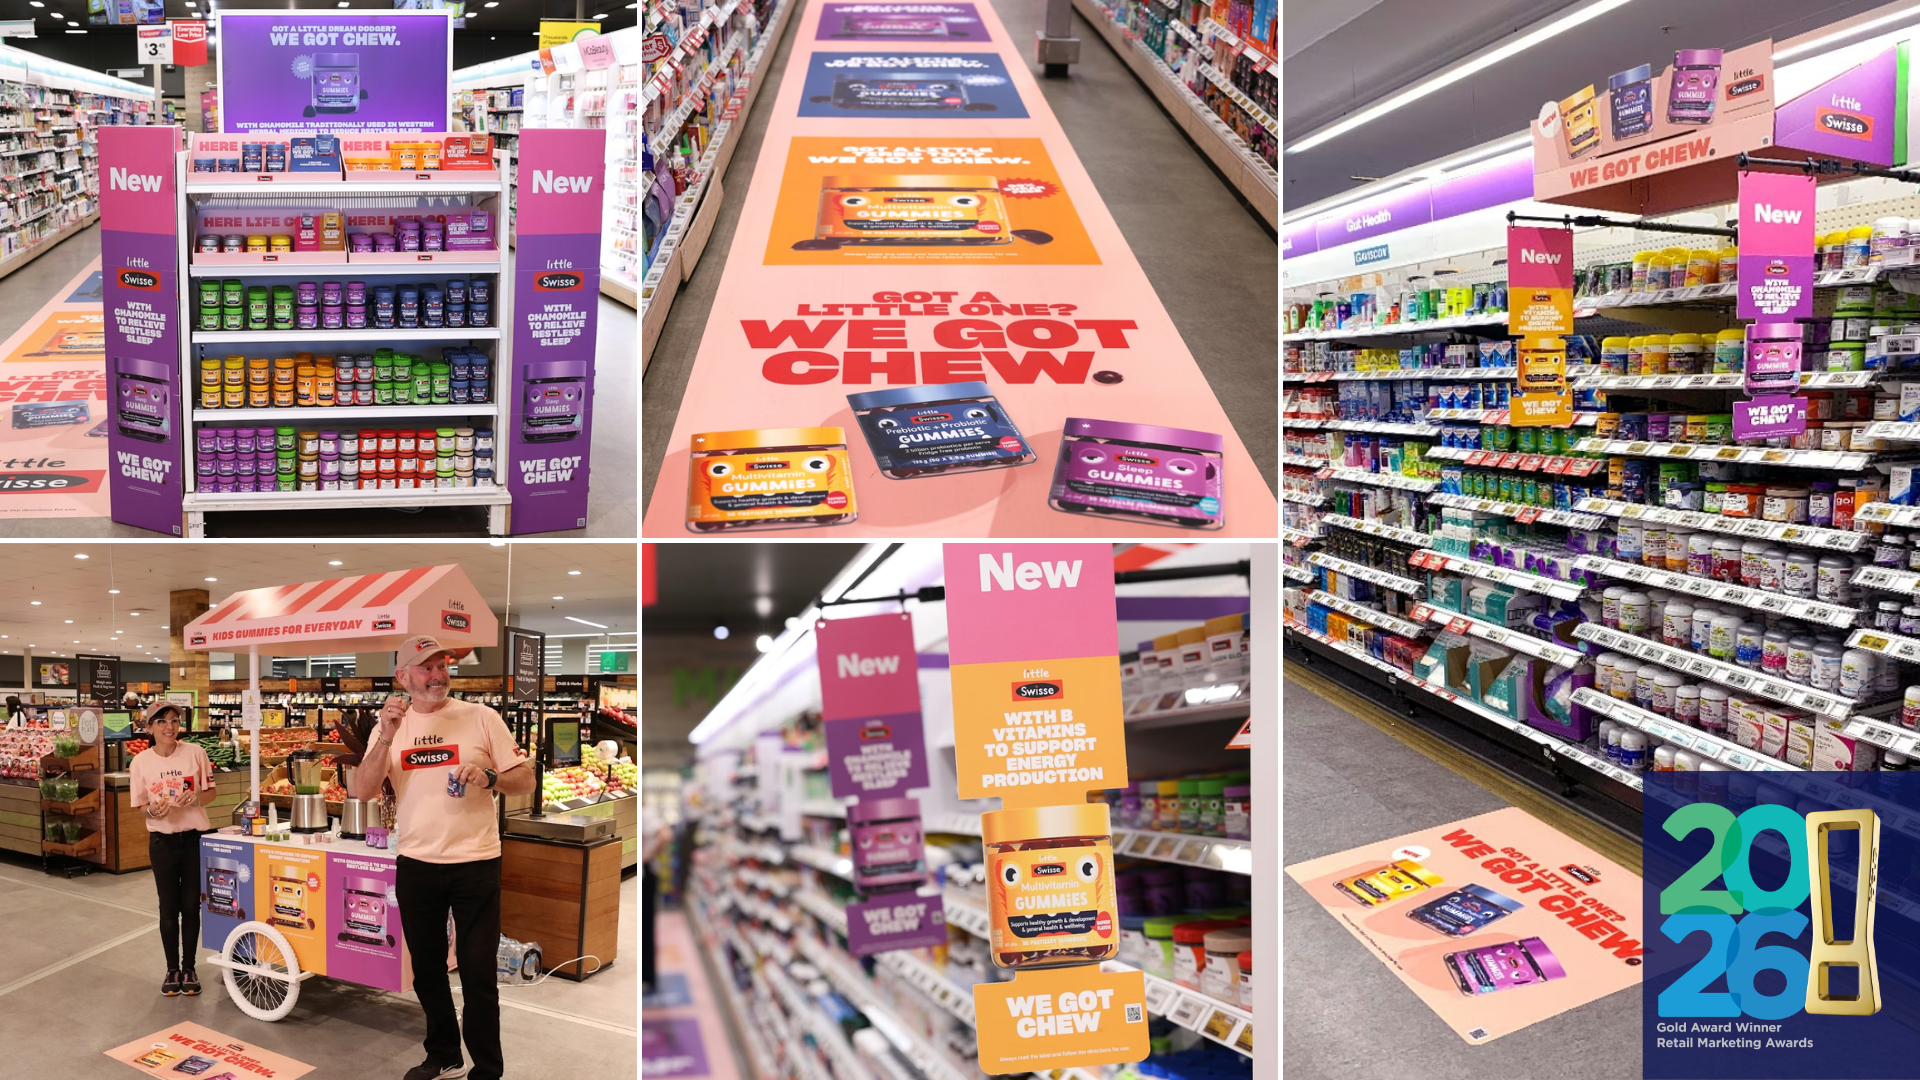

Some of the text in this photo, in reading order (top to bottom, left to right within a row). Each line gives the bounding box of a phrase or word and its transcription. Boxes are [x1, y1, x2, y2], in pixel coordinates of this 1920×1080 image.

[270, 33, 401, 46] WE GOT CHEW.
[148, 43, 159, 56] 3
[1733, 68, 1754, 80] little
[1731, 82, 1758, 95] Swisse
[1831, 94, 1862, 111] little
[1542, 110, 1557, 128] NEW
[1826, 115, 1863, 133] Swisse
[199, 141, 238, 151] HERE
[343, 141, 382, 151] HERE
[1570, 137, 1716, 188] WE GOT CHEW.
[110, 167, 162, 192] New
[532, 170, 593, 194] New
[1346, 208, 1392, 232] Gut Health
[1754, 203, 1802, 224] New
[204, 217, 280, 227] HERE LIFE
[348, 216, 385, 226] HERE
[1355, 247, 1387, 263] GAVISCON
[1521, 248, 1562, 265] New
[127, 256, 149, 268] little
[547, 259, 573, 270] little
[124, 273, 153, 286] Swisse
[542, 276, 575, 287] Swisse
[872, 291, 1002, 304] GOT A
[127, 301, 152, 312] WITH
[544, 304, 572, 312] WITH
[797, 303, 1078, 316] LITTLE ONE?
[114, 308, 166, 322] CHAMOMILE
[527, 311, 587, 322] CHAMOMILE
[116, 316, 165, 330] TO RELIEVE
[529, 320, 585, 330] TO RELIEVE
[119, 326, 162, 338] RESTLESS
[532, 328, 581, 338] RESTLESS
[740, 318, 1139, 350] WE GOT
[1522, 400, 1539, 408] WE
[1748, 404, 1795, 417] WE GOT
[886, 425, 931, 435] Prebiotic
[942, 419, 988, 429] Probiotic
[930, 443, 963, 452] probiotics
[953, 445, 982, 453] probiotic
[117, 451, 172, 473] WE GOT
[519, 456, 582, 473] WE GOT
[1121, 456, 1151, 465] Swisse
[731, 470, 806, 481] Multivitamin
[1117, 464, 1153, 475] Sleep
[784, 499, 812, 507] wellbeing
[979, 552, 1083, 592] New
[448, 599, 465, 611] little
[446, 615, 467, 628] Swisse
[212, 619, 363, 641] KIDS GUMMIES FOR EVERYDAY
[836, 653, 900, 679] New
[1023, 668, 1050, 679] little
[1021, 685, 1055, 697] Swisse
[1004, 709, 1073, 726] WITH B
[993, 723, 1087, 742] VITAMINS
[414, 735, 444, 746] little
[984, 737, 1097, 757] TO SUPPORT
[410, 752, 449, 764] Swisse
[1006, 754, 1078, 771] ENERGY
[982, 767, 1104, 788] PRODUCTION
[1401, 849, 1422, 859] NEW
[1441, 828, 1497, 860] WE
[1481, 857, 1554, 894] GOT
[1037, 867, 1061, 875] Swisse
[1021, 880, 1080, 892] Multivitamin
[1500, 847, 1626, 922] GOT A LITTLE ONE?
[863, 903, 927, 924] WE GOT
[1026, 926, 1043, 934] general
[1064, 922, 1085, 930] wellbeing
[1029, 919, 1046, 927] healthy
[1047, 918, 1063, 926] growth
[1068, 916, 1096, 924] development
[1005, 989, 1114, 1018] WE GOT
[168, 1033, 276, 1079] WE GOT CHEW.
